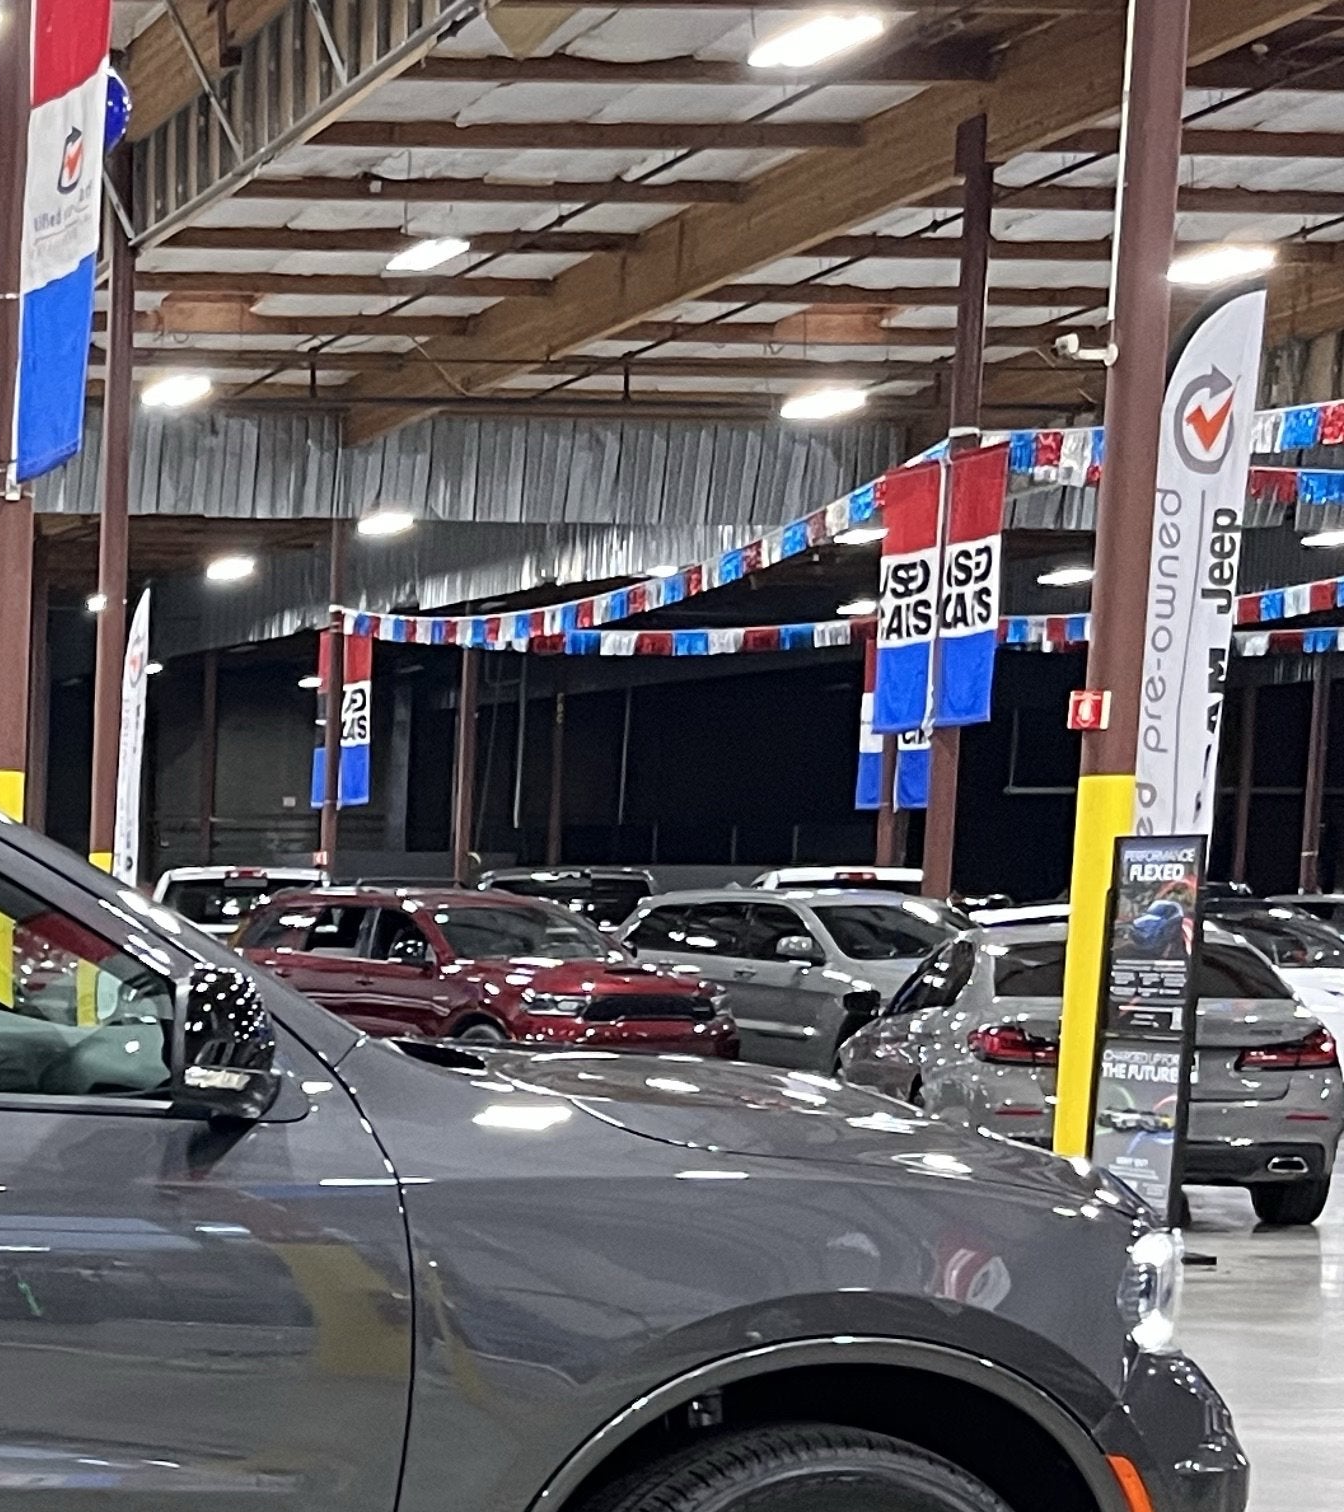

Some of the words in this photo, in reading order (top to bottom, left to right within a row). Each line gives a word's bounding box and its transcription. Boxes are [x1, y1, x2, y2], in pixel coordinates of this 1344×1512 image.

[1201, 507, 1243, 615] Jeep
[1143, 487, 1182, 753] pre-owned
[1129, 863, 1185, 882] FLEXED
[1102, 1061, 1126, 1079] THE
[1127, 1064, 1180, 1084] FUTURE
